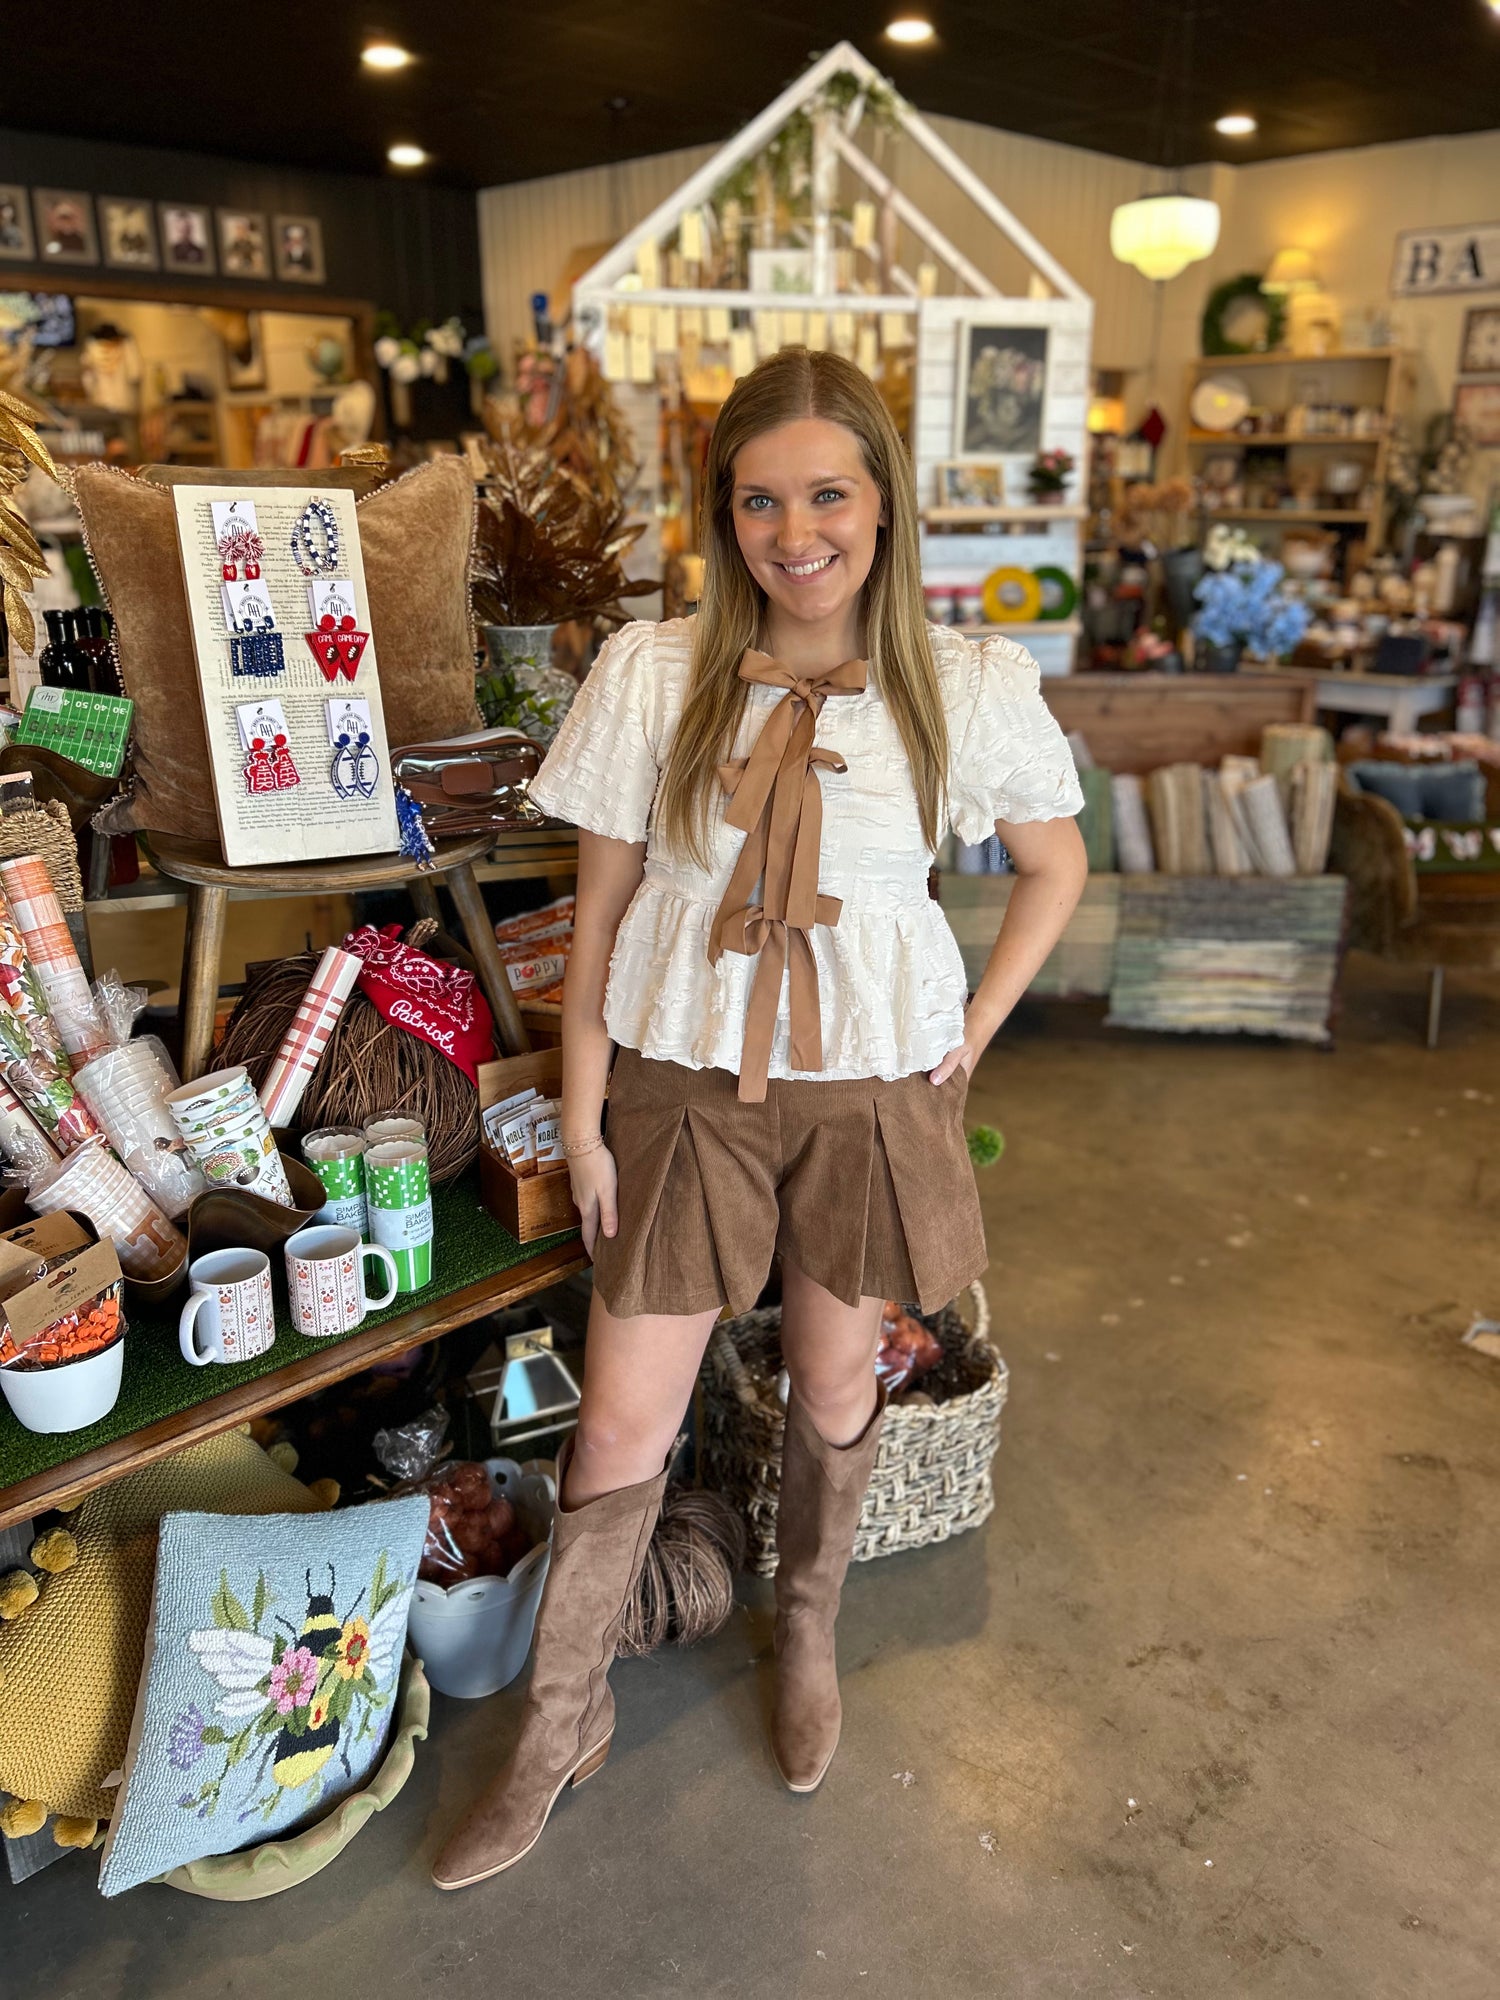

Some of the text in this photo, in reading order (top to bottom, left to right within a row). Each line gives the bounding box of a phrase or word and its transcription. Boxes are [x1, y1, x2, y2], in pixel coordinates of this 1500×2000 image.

[330, 602, 342, 616] AH
[75, 701, 89, 709] 50
[260, 723, 274, 737] AH
[346, 719, 359, 734] AH
[98, 760, 112, 769] 30
[280, 754, 297, 788] CHEER
[256, 759, 274, 790] CHEER
[389, 999, 455, 1056] Patriots
[506, 1127, 526, 1145] NOBLE
[538, 1128, 559, 1143] NOBLE
[124, 1208, 177, 1259] T
